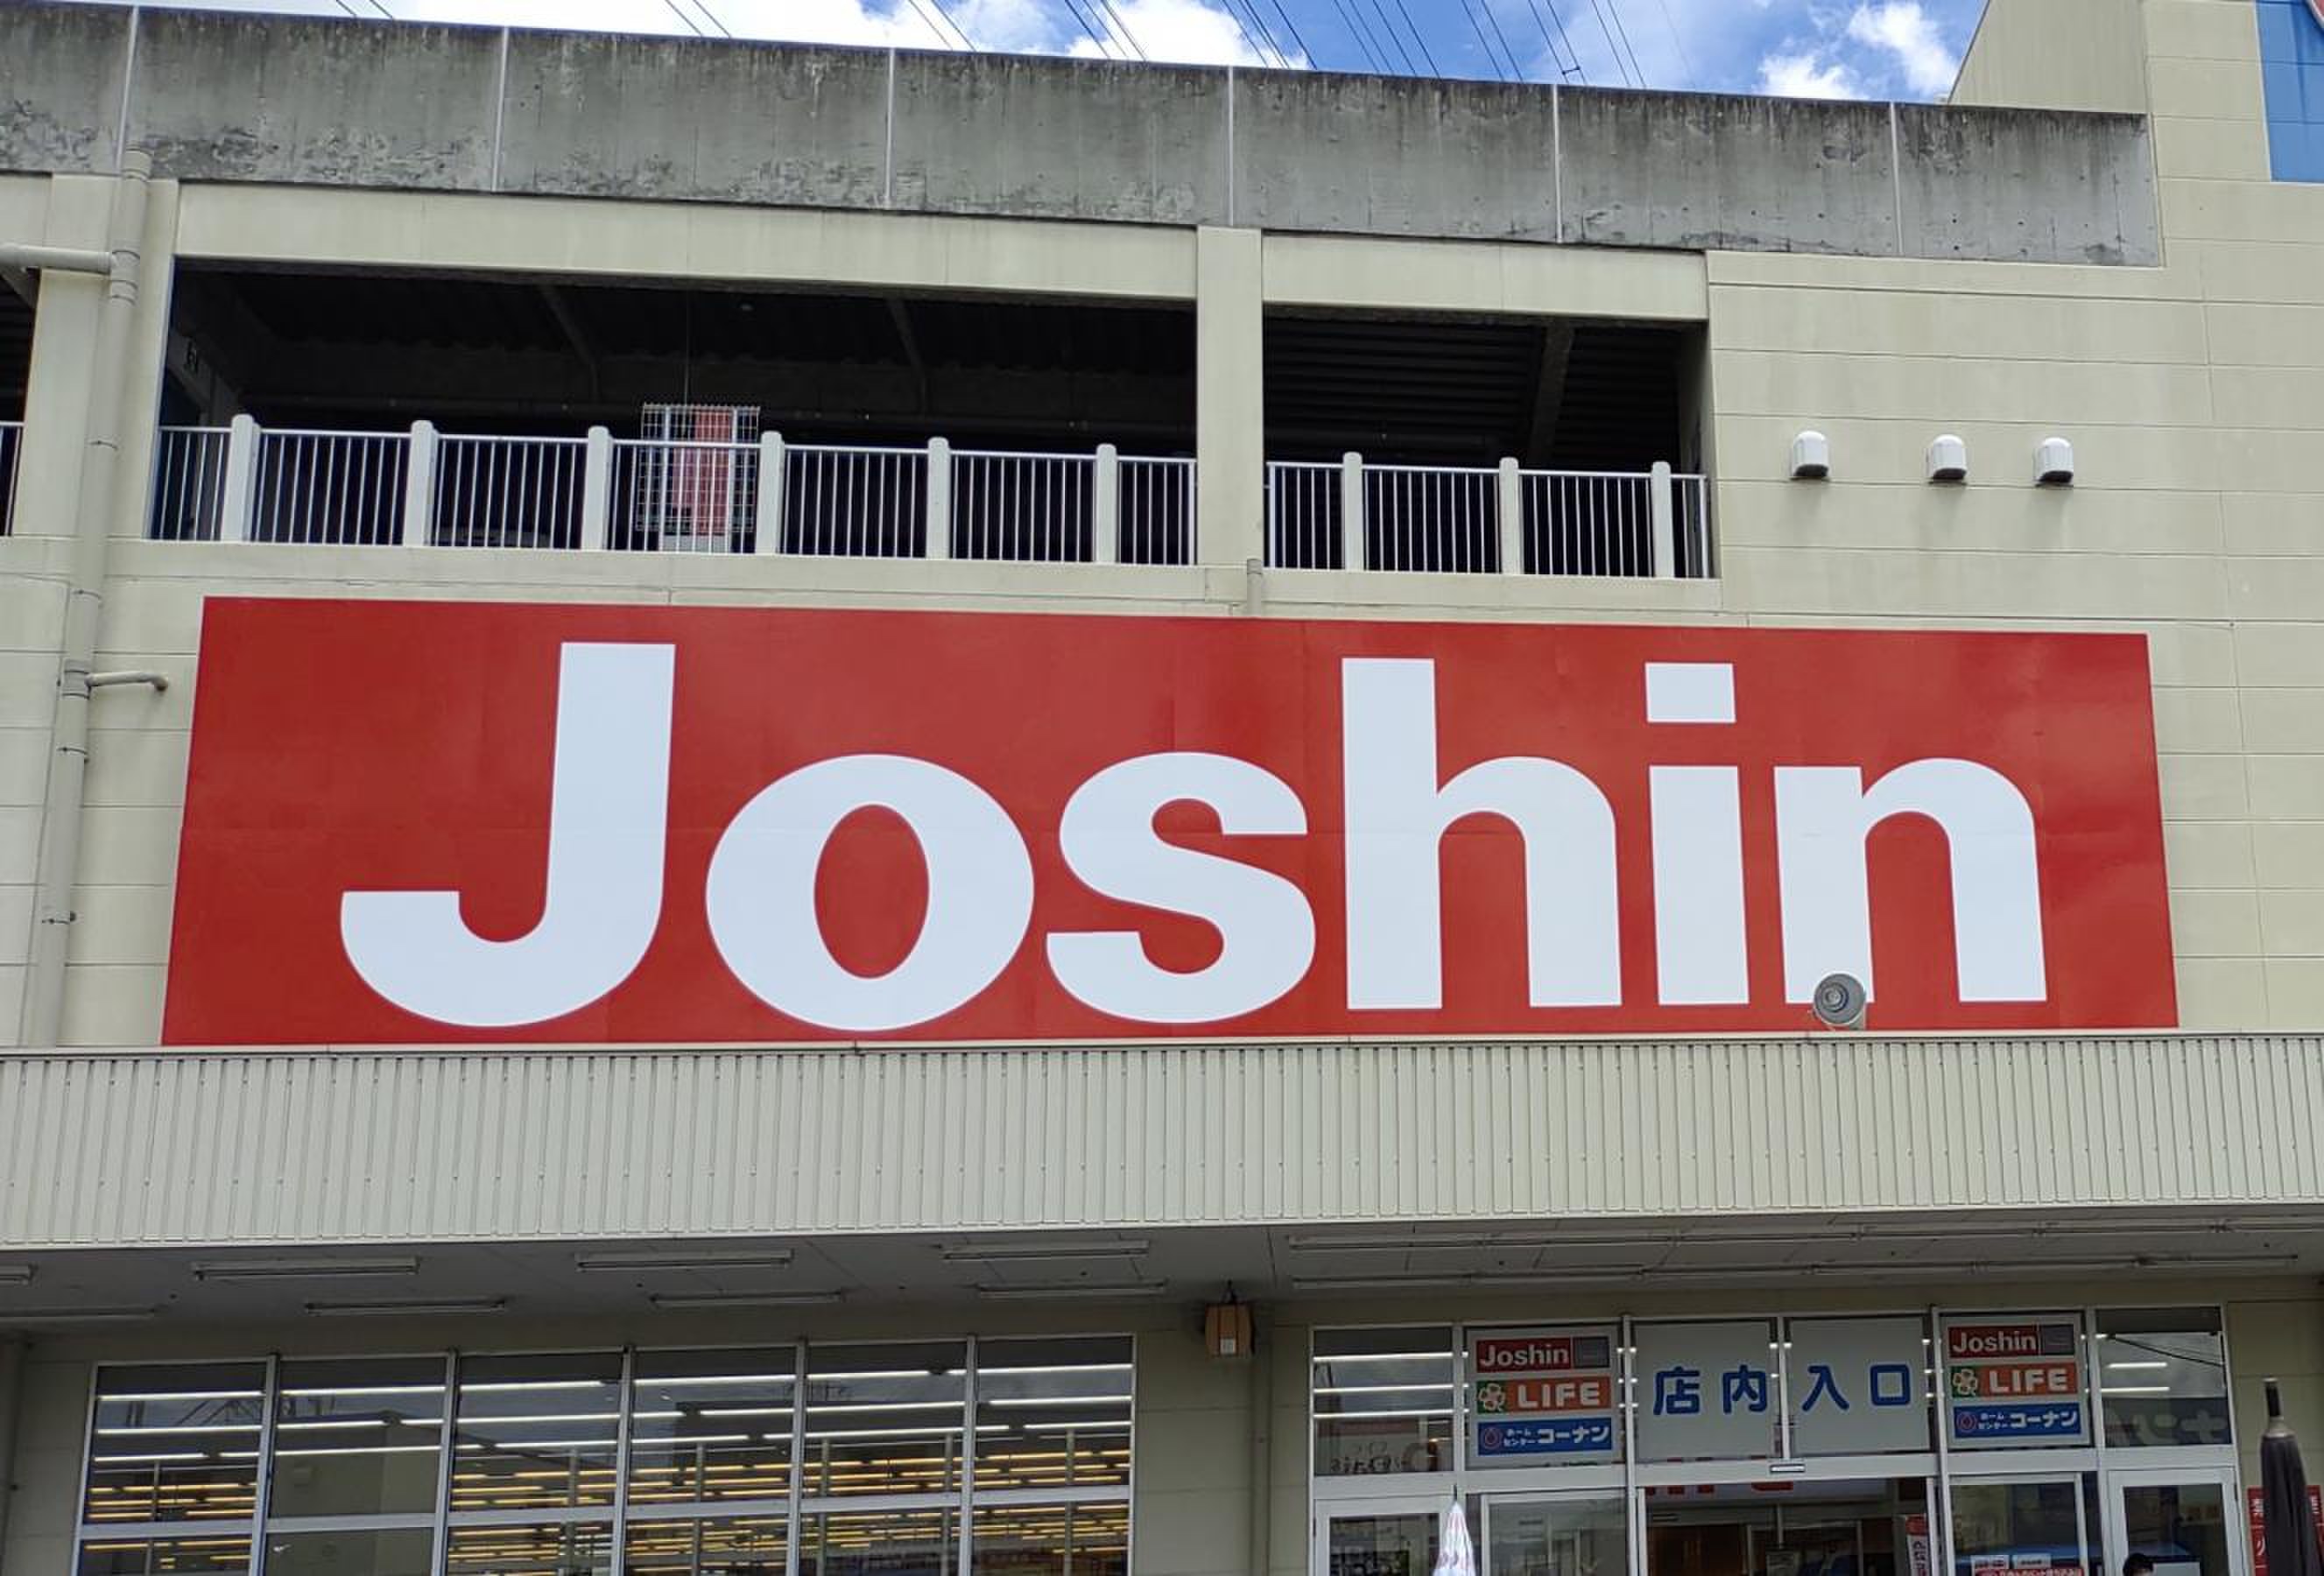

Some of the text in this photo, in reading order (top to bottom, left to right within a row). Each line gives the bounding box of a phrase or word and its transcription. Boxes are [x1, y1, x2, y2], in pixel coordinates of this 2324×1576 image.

[340, 641, 2047, 1031] Joshin
[1953, 1330, 2038, 1354] Joshin
[1479, 1344, 1570, 1367] Joshin
[1652, 1363, 1912, 1416] 店内入口
[1989, 1368, 2068, 1393] LIFE
[1517, 1382, 1601, 1408] LIFE
[2010, 1410, 2079, 1429] コーナン
[1537, 1425, 1609, 1445] コーナン
